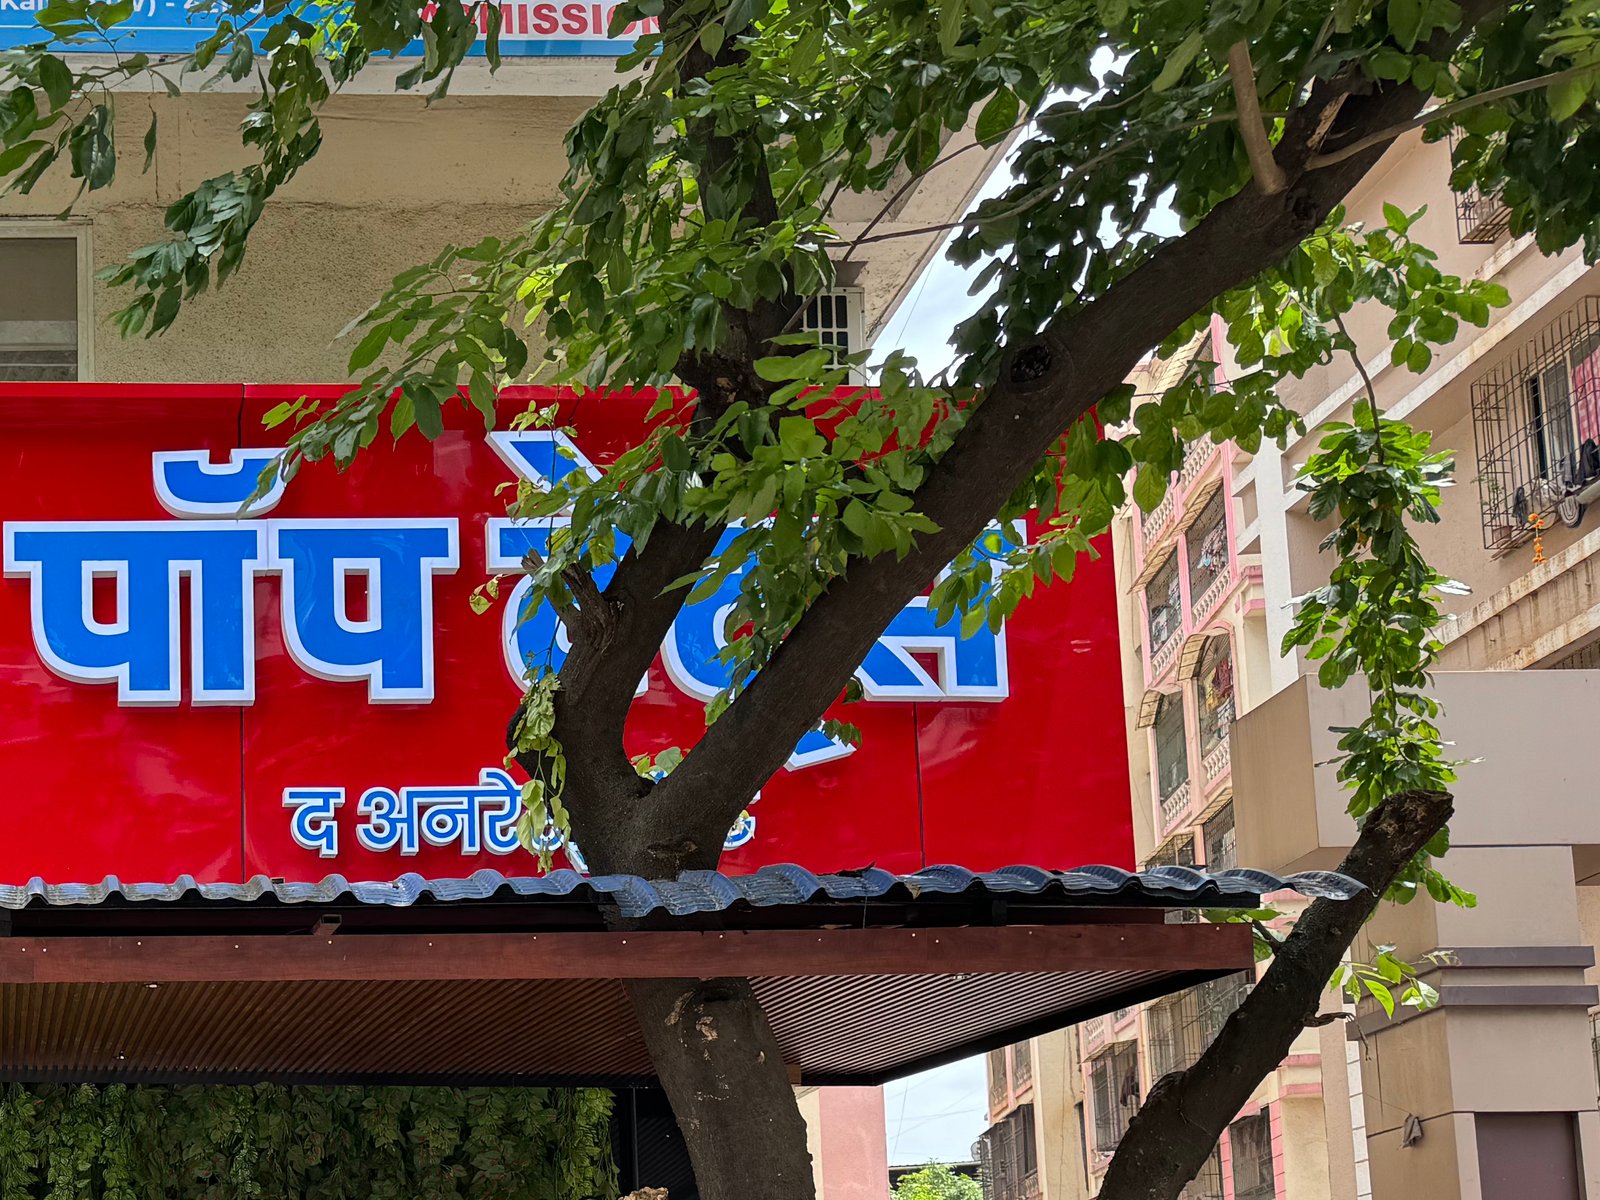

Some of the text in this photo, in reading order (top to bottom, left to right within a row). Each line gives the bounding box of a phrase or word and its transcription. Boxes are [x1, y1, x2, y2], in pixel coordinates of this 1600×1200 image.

[419, 3, 660, 35] MISSI
[3, 447, 460, 708] पॉप
[282, 785, 346, 858] द
